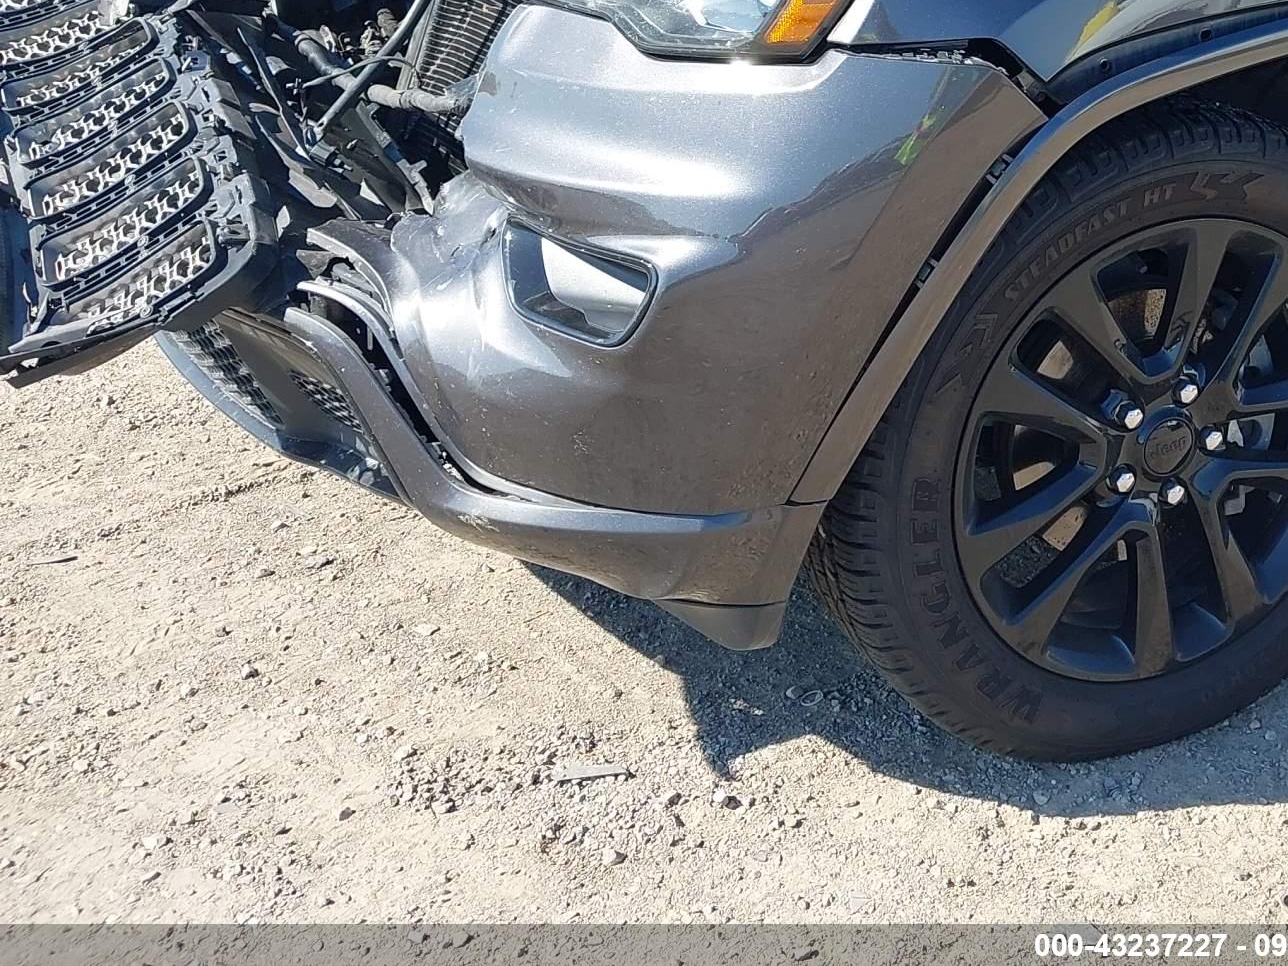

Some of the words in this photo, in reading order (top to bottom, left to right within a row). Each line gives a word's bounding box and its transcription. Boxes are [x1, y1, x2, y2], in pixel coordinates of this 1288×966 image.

[1004, 197, 1134, 301] STEADFAST
[1143, 184, 1177, 207] HT
[1150, 436, 1187, 459] Jeep
[910, 476, 1043, 725] WRANGLER
